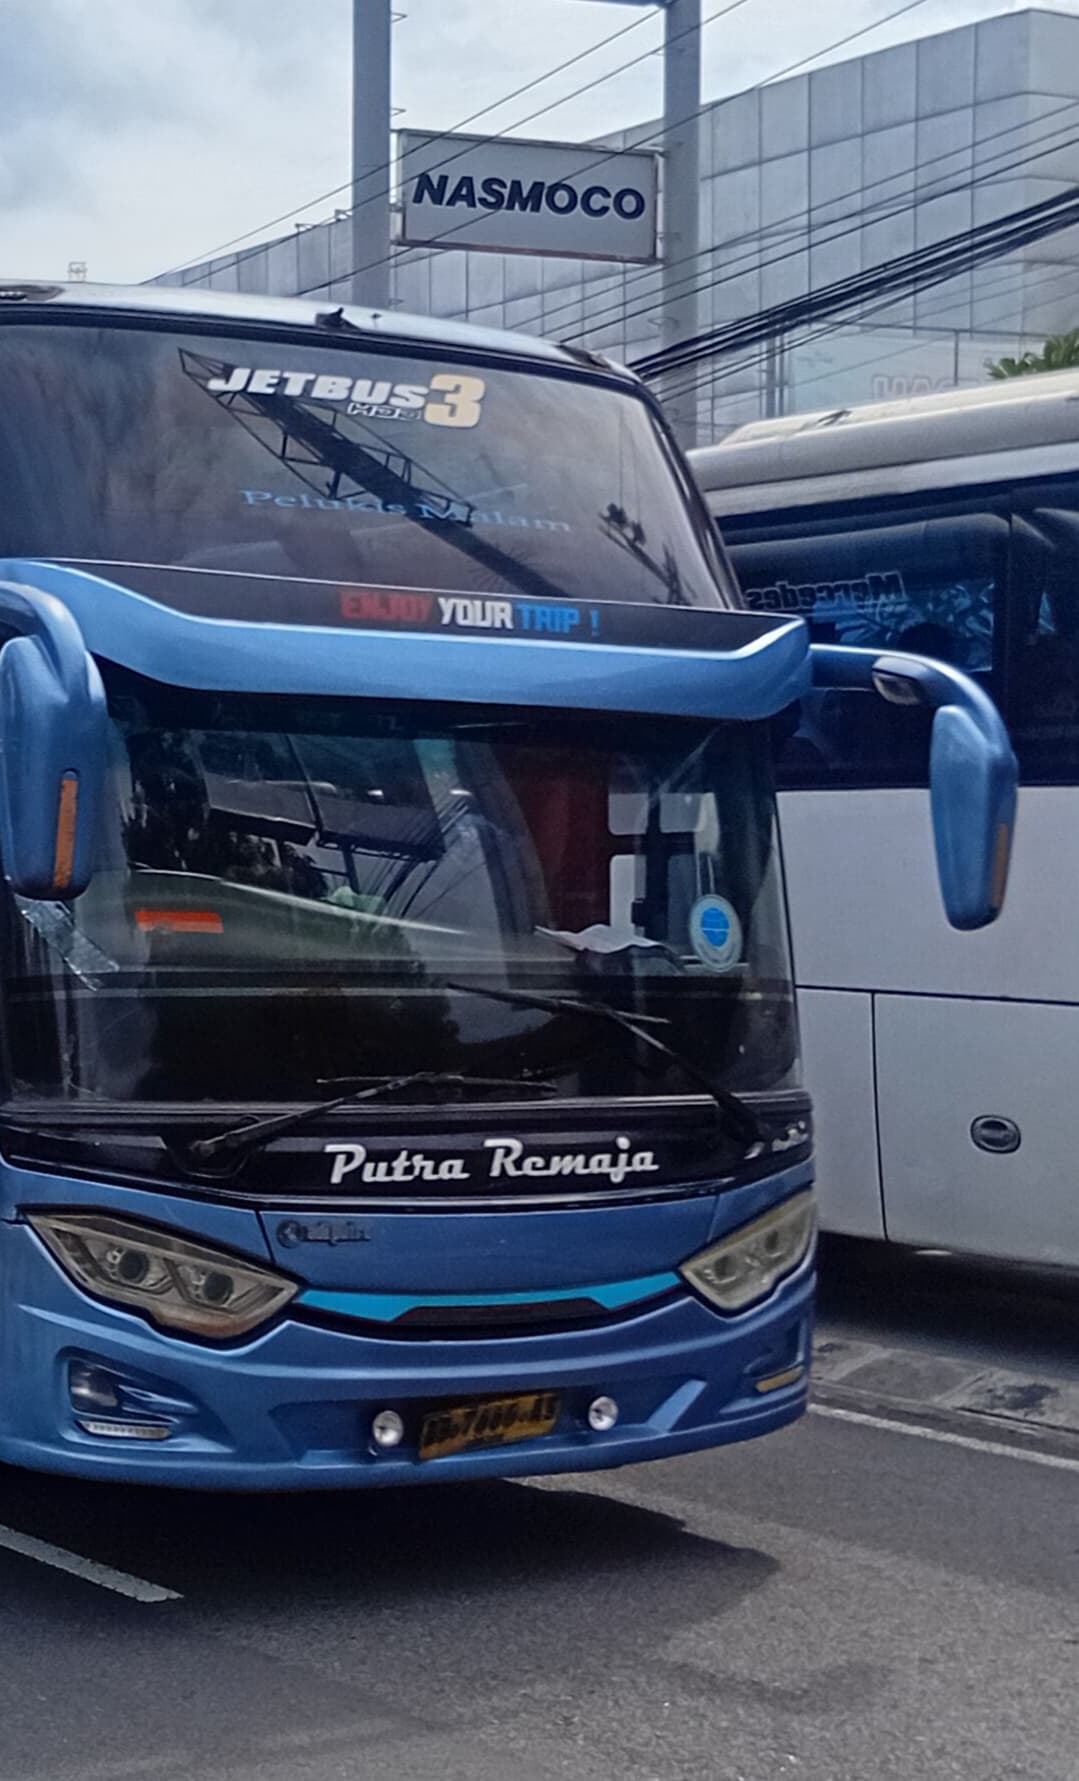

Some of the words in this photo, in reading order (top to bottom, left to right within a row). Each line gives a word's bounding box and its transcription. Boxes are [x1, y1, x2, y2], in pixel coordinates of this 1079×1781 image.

[411, 172, 646, 221] NASMOCO
[239, 489, 407, 517] Pelukis
[413, 503, 573, 532] Malam
[340, 591, 431, 622] ENJOY
[437, 596, 514, 630] YOUR
[516, 602, 580, 633] TRIP
[324, 1143, 472, 1186] Putra
[482, 1136, 660, 1186] Remaja
